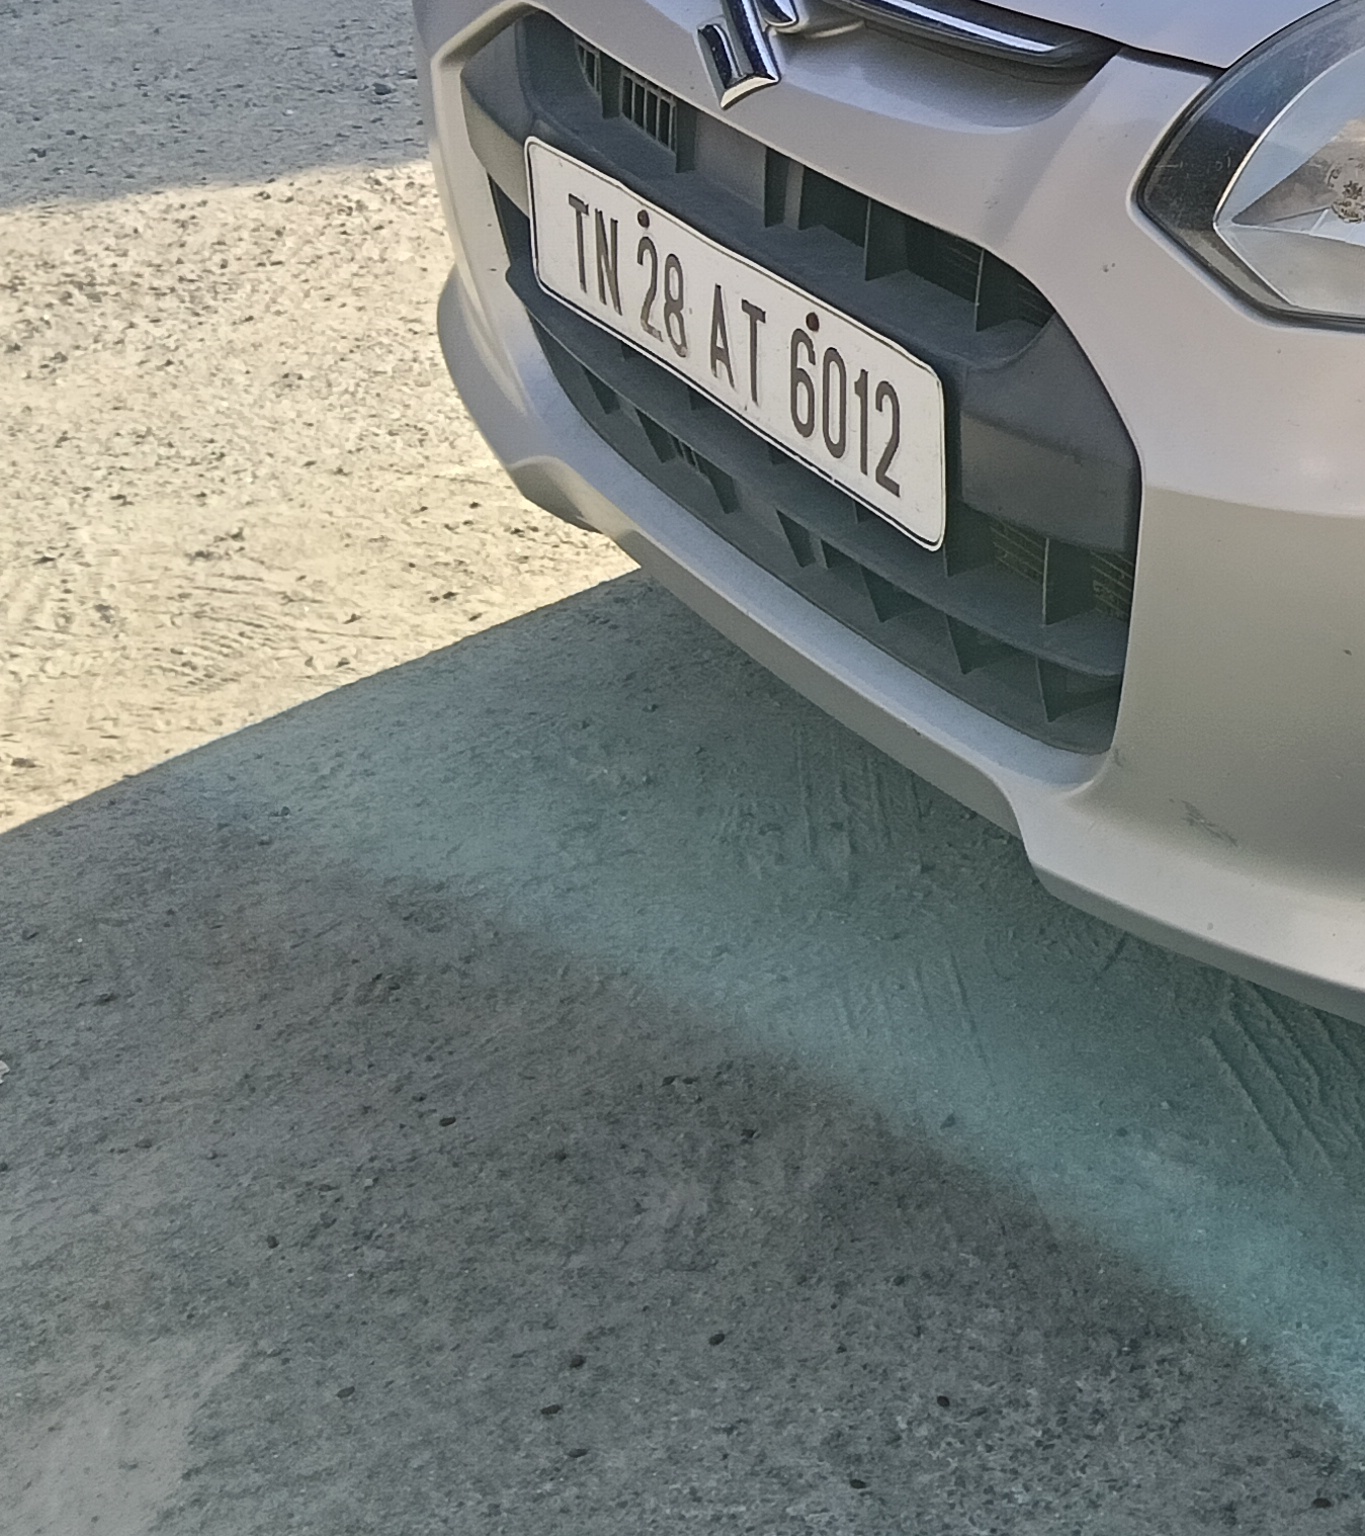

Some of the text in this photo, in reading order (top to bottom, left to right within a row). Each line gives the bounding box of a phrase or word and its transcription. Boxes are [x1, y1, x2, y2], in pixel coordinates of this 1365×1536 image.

[568, 193, 901, 498] TN 28 AT 6012
